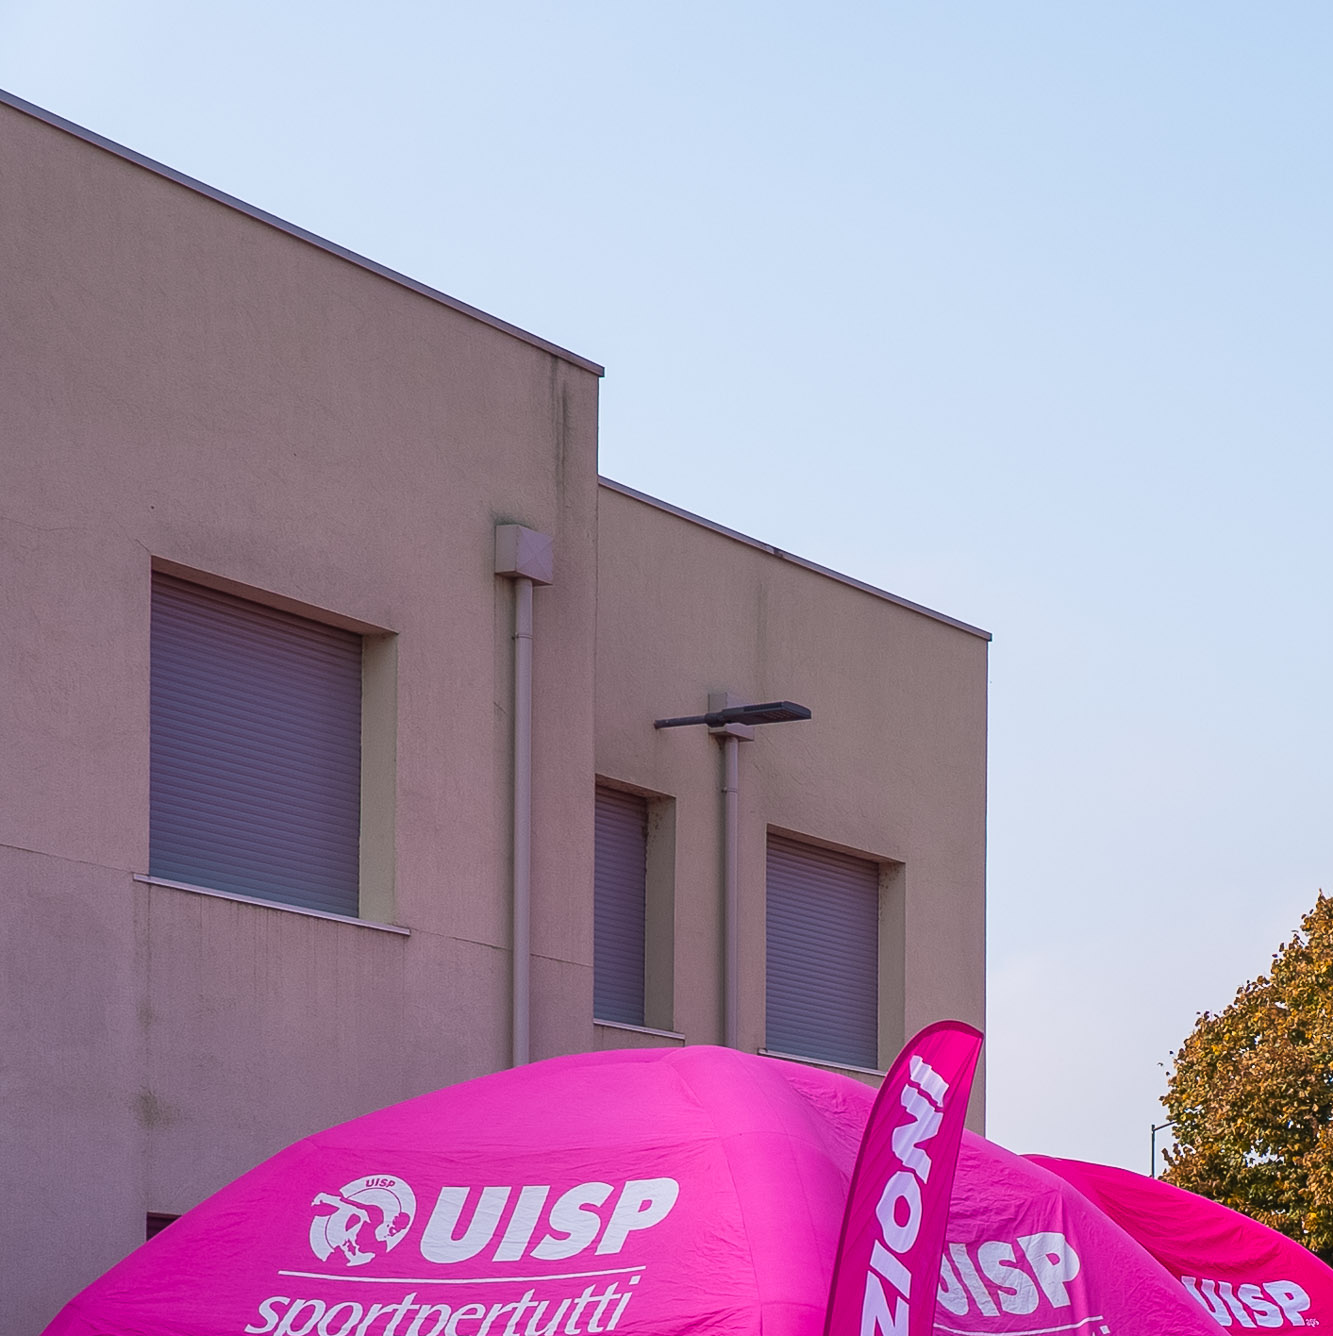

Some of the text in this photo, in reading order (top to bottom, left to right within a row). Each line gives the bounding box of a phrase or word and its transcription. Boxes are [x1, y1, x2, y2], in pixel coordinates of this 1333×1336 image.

[365, 1178, 396, 1188] UISP
[420, 1177, 680, 1264] UISP
[1181, 1275, 1311, 1328] UISP
